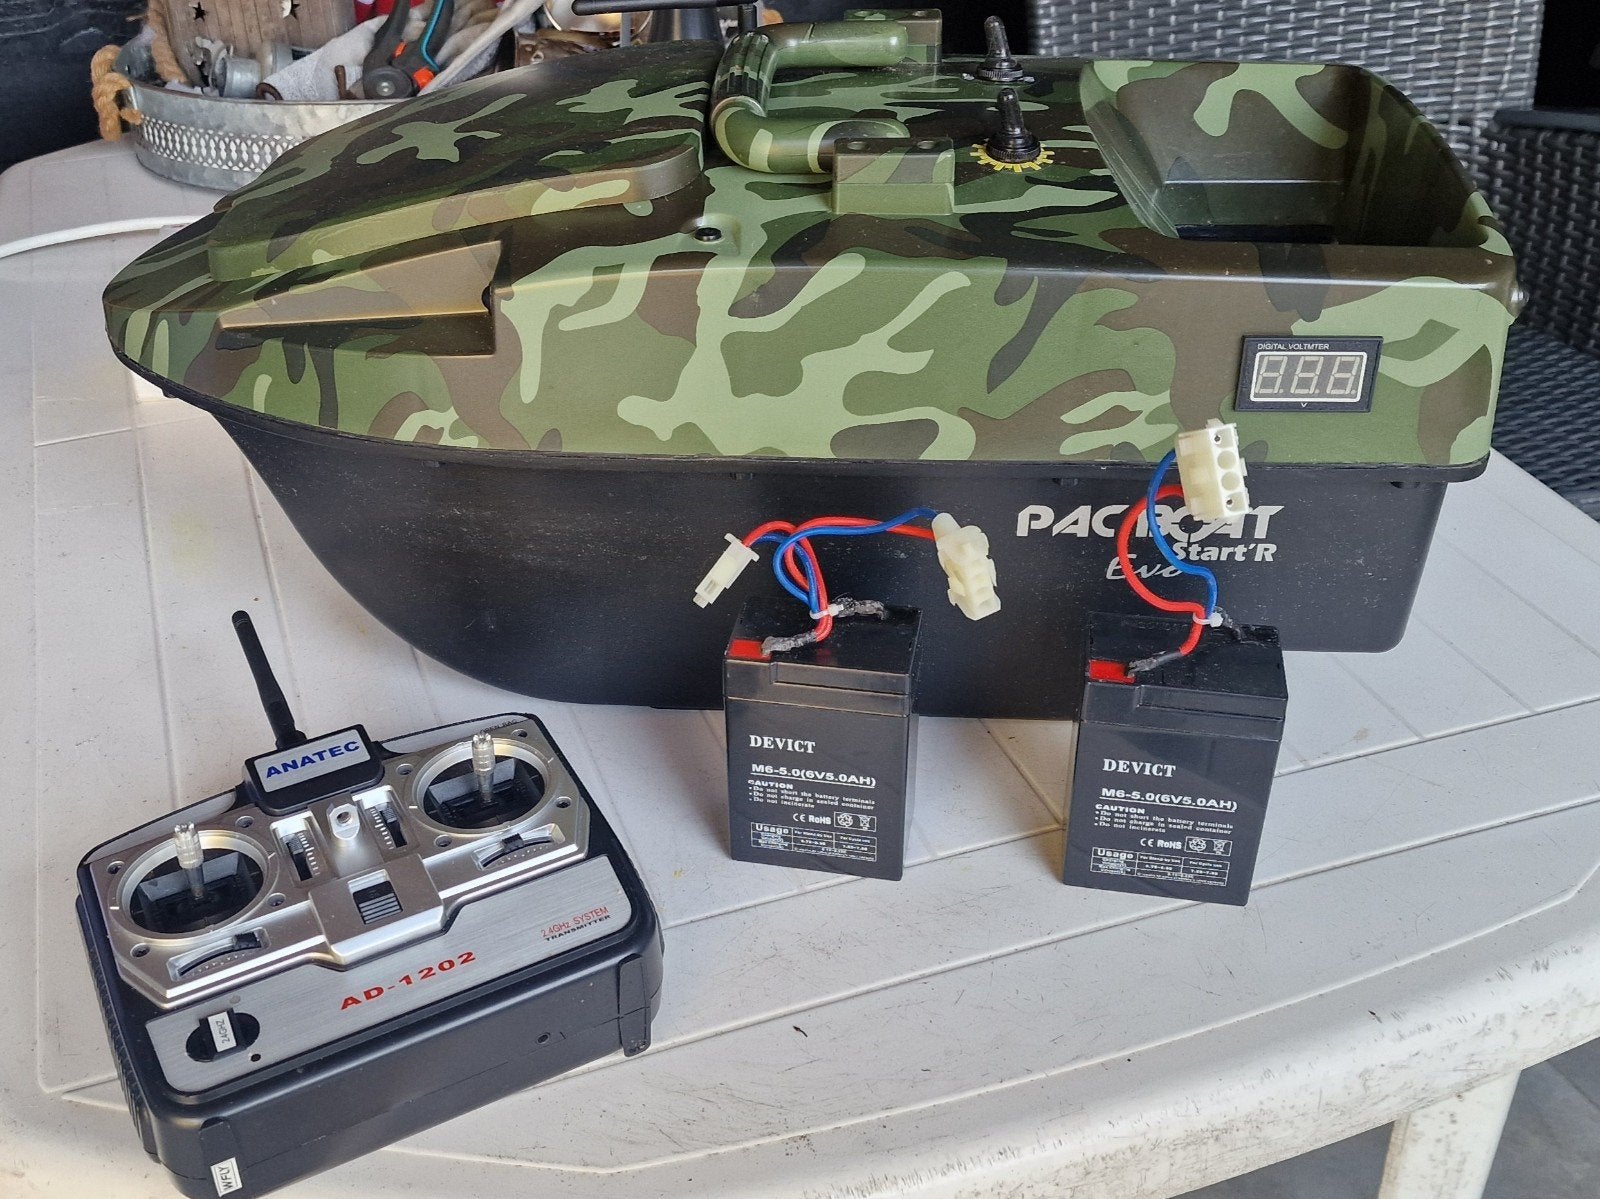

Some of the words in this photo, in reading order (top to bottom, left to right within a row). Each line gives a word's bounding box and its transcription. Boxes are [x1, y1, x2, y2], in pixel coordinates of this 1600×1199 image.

[750, 735, 816, 753] DEVICT
[266, 741, 360, 778] ANATEC
[1102, 758, 1176, 777] DEVICT
[752, 764, 876, 787] M6-5.0(6V5.0AH)
[748, 780, 794, 790] CAUTION
[1102, 788, 1238, 811] M6-5.0(6V5.0AH)
[1096, 804, 1145, 814] CAUTION
[756, 823, 789, 835] Usage
[809, 815, 832, 825] RoHS
[1157, 839, 1182, 850] RoHS
[1097, 848, 1134, 860] Usage
[573, 907, 609, 925] SYSTEM
[545, 915, 611, 941] TRANSMITTER
[340, 951, 476, 1010] AD-1202
[218, 1167, 233, 1190] WFLY
